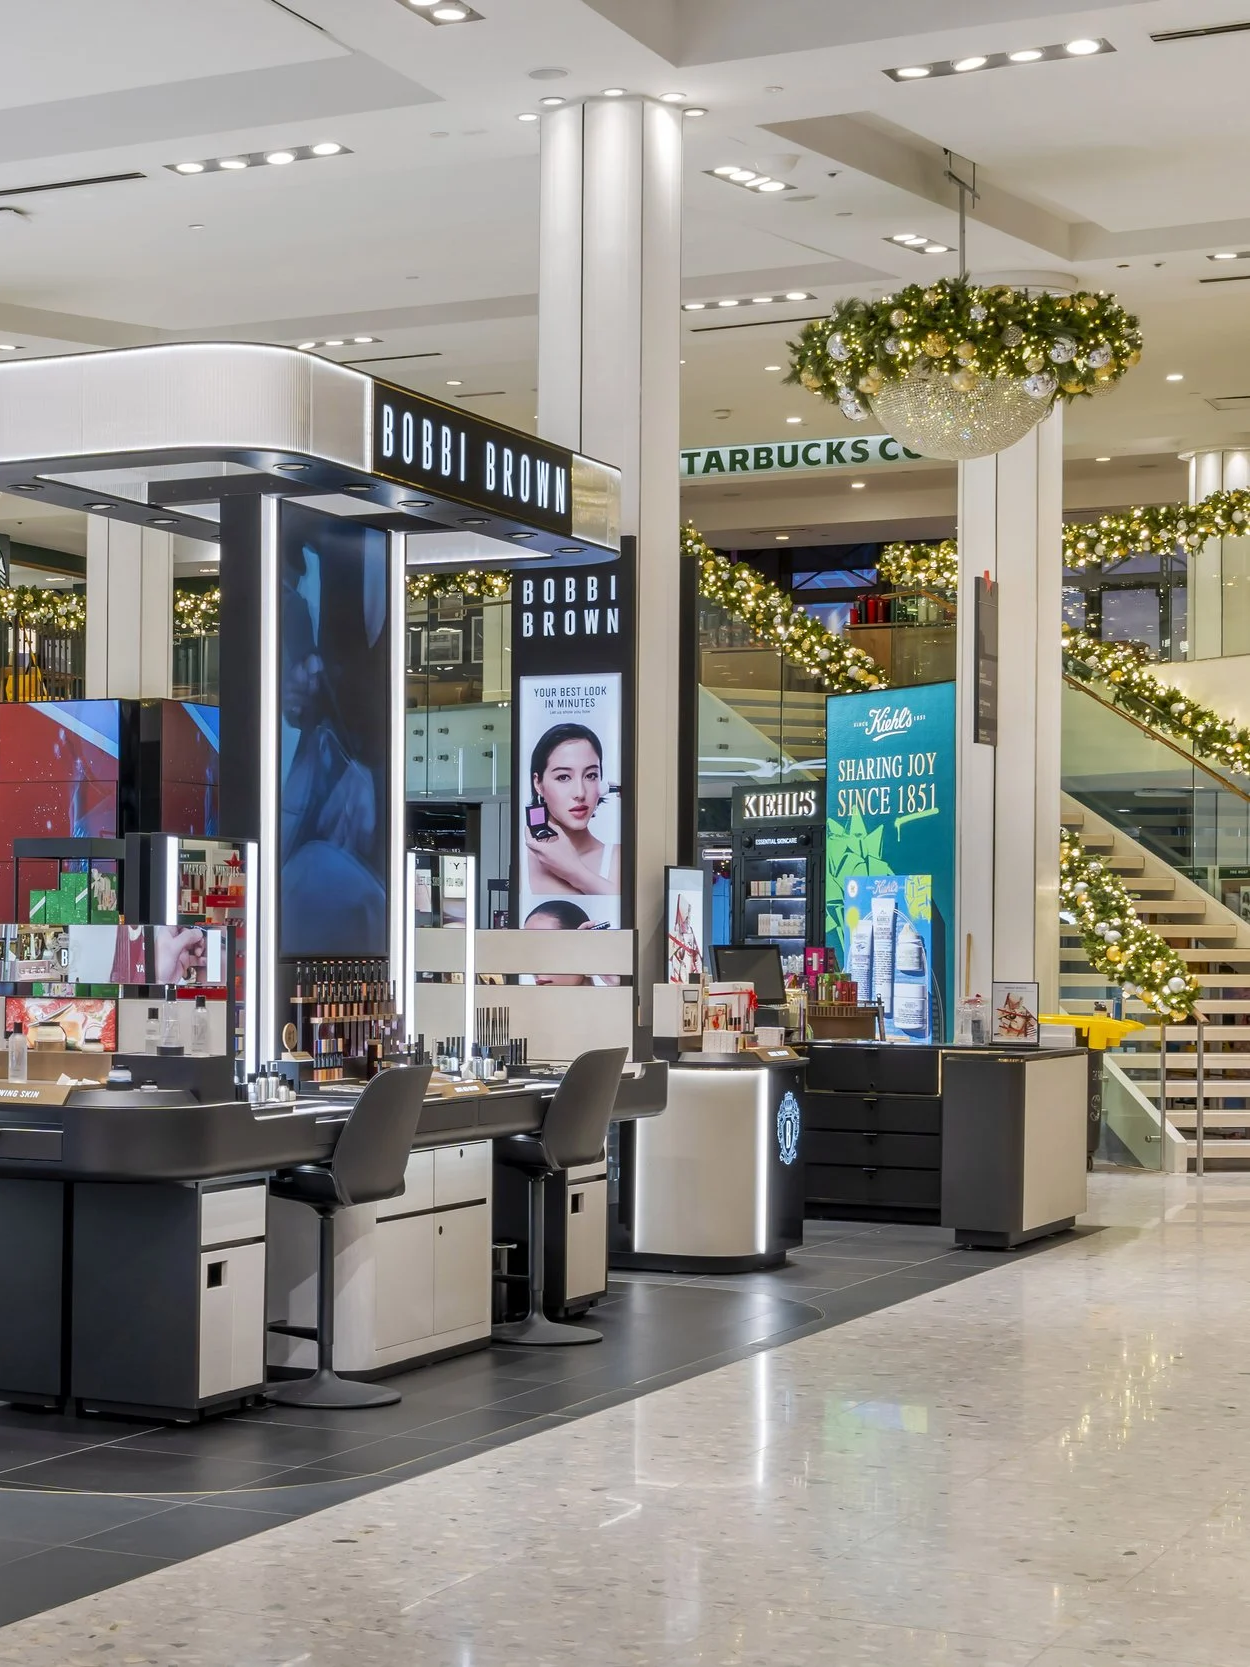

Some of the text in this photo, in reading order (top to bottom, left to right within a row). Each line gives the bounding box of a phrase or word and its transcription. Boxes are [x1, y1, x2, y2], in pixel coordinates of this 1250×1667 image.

[382, 404, 566, 515] BOBBI BROWN
[681, 438, 870, 476] TARBUCKS
[522, 575, 616, 605] BOBBI
[522, 608, 619, 637] BROWN
[533, 685, 607, 698] YOUR BEST LOOK
[545, 697, 596, 708] IN MINUTES
[853, 720, 869, 728] SINCE
[864, 706, 913, 736] Kiehl's
[838, 752, 937, 782] SHARING JOY
[743, 790, 816, 819] KIEHL'S
[837, 783, 936, 817] SINCE 1851
[755, 837, 798, 846] ESSENTIAL SKINCARE
[19, 1089, 40, 1099] SKIN
